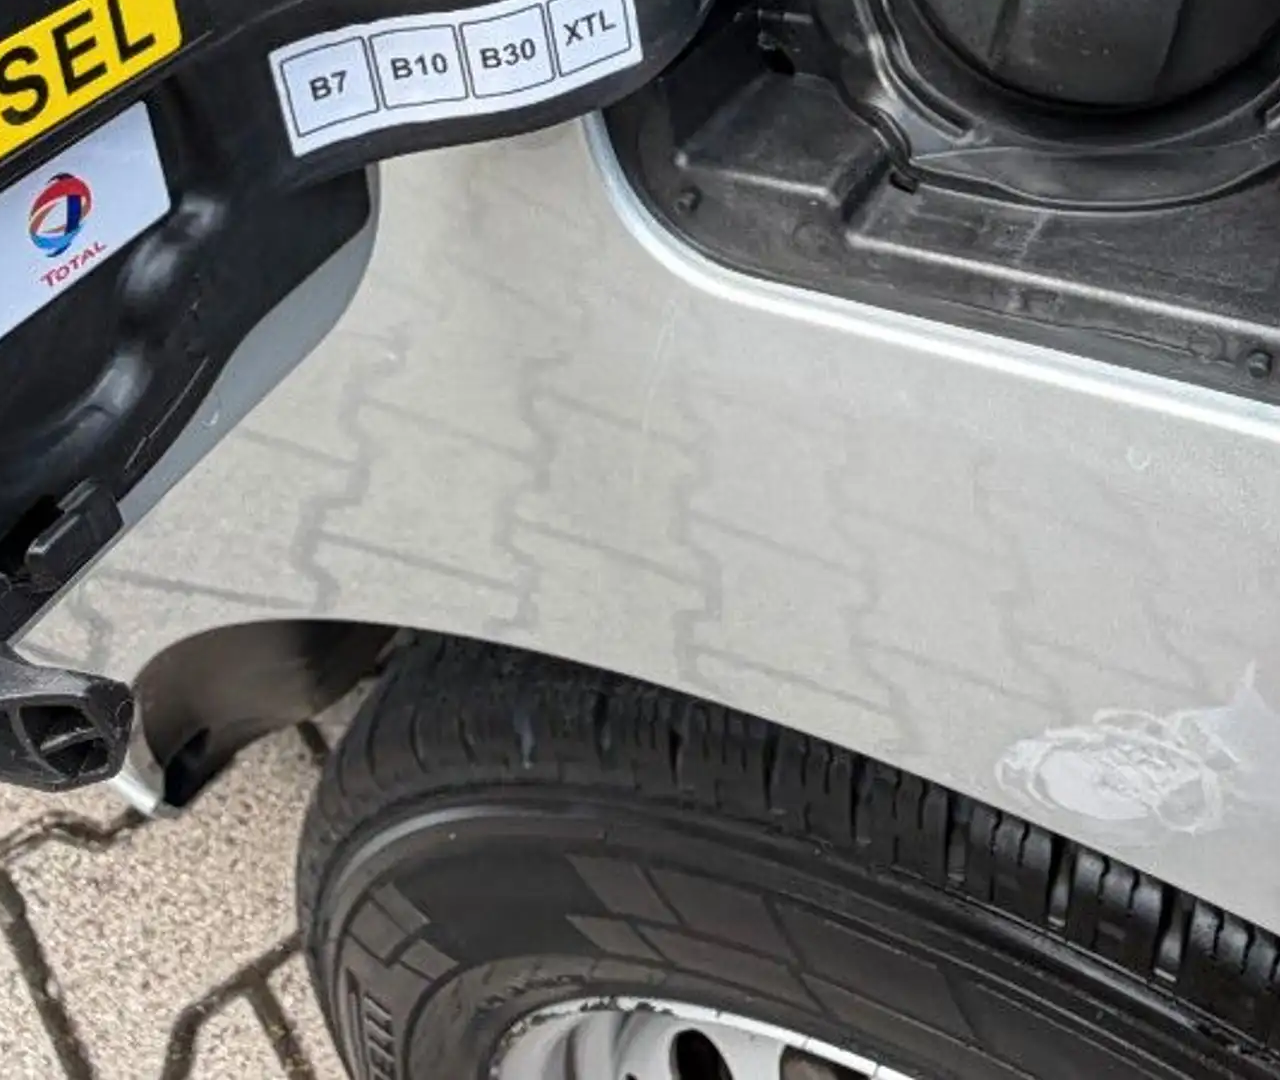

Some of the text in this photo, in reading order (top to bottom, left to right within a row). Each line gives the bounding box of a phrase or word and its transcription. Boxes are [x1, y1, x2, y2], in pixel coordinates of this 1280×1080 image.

[309, 10, 617, 101] B7 B10 B30 XTL
[41, 241, 107, 287] TOTAL
